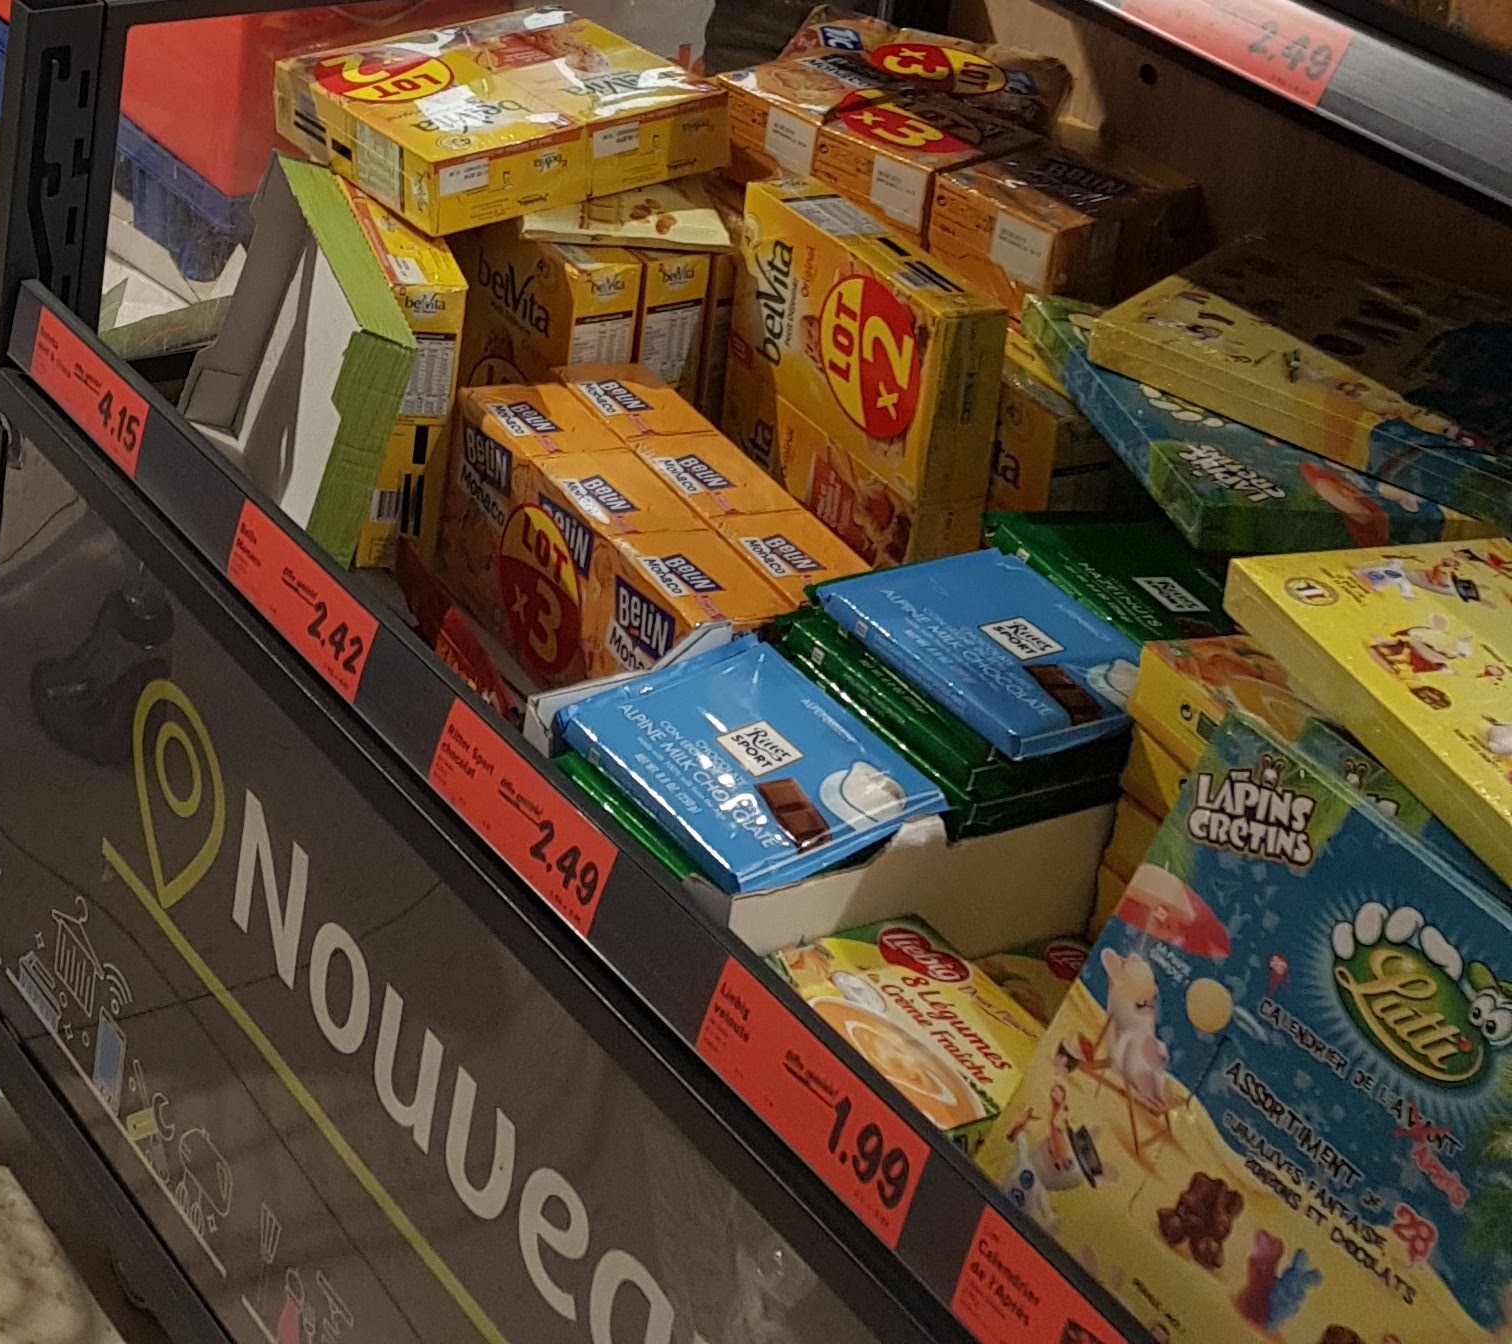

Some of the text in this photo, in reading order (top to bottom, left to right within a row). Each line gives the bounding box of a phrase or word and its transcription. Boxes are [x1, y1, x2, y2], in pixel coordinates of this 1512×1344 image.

[883, 47, 950, 80] x3
[958, 62, 994, 92] LOT
[1248, 20, 1334, 82] 2.49
[375, 71, 440, 99] LOT
[854, 111, 945, 147] x3
[405, 293, 446, 311] belVita
[478, 245, 551, 338] belVita
[755, 239, 795, 368] belVita
[828, 291, 859, 382] LOT
[860, 316, 918, 420] x2
[98, 389, 141, 453] 4.15
[491, 404, 526, 435] Monaco
[581, 383, 617, 414] Monaco
[662, 457, 698, 493] Monaco
[520, 516, 568, 584] LOT
[646, 558, 683, 594] Monaco
[744, 536, 789, 576] Monaco
[307, 601, 364, 675] 2.42
[511, 582, 562, 662] x3
[991, 625, 1037, 656] SPORT
[1008, 621, 1055, 652] Ritter
[441, 741, 476, 780] chocolat
[448, 723, 495, 777] Ritter Sport
[731, 733, 773, 769] SPORT
[745, 726, 791, 763] Ritter
[618, 703, 667, 743] ALPINE
[660, 742, 694, 772] MILK
[692, 770, 779, 849] CHOOLATE
[1196, 772, 1317, 832] LAPINS
[530, 819, 599, 906] 2.49
[881, 931, 960, 983] Liebig
[720, 982, 751, 1021] Liebig
[881, 983, 932, 1028] Crème
[901, 976, 930, 988] 8
[918, 990, 1012, 1072] Légumes
[1334, 946, 1480, 1080] Lutti
[1259, 997, 1350, 1079] CALENDRIER
[232, 789, 688, 1344] Nouvea
[828, 1096, 910, 1209] 1.99
[1225, 1062, 1365, 1189] ASSORTIMENT
